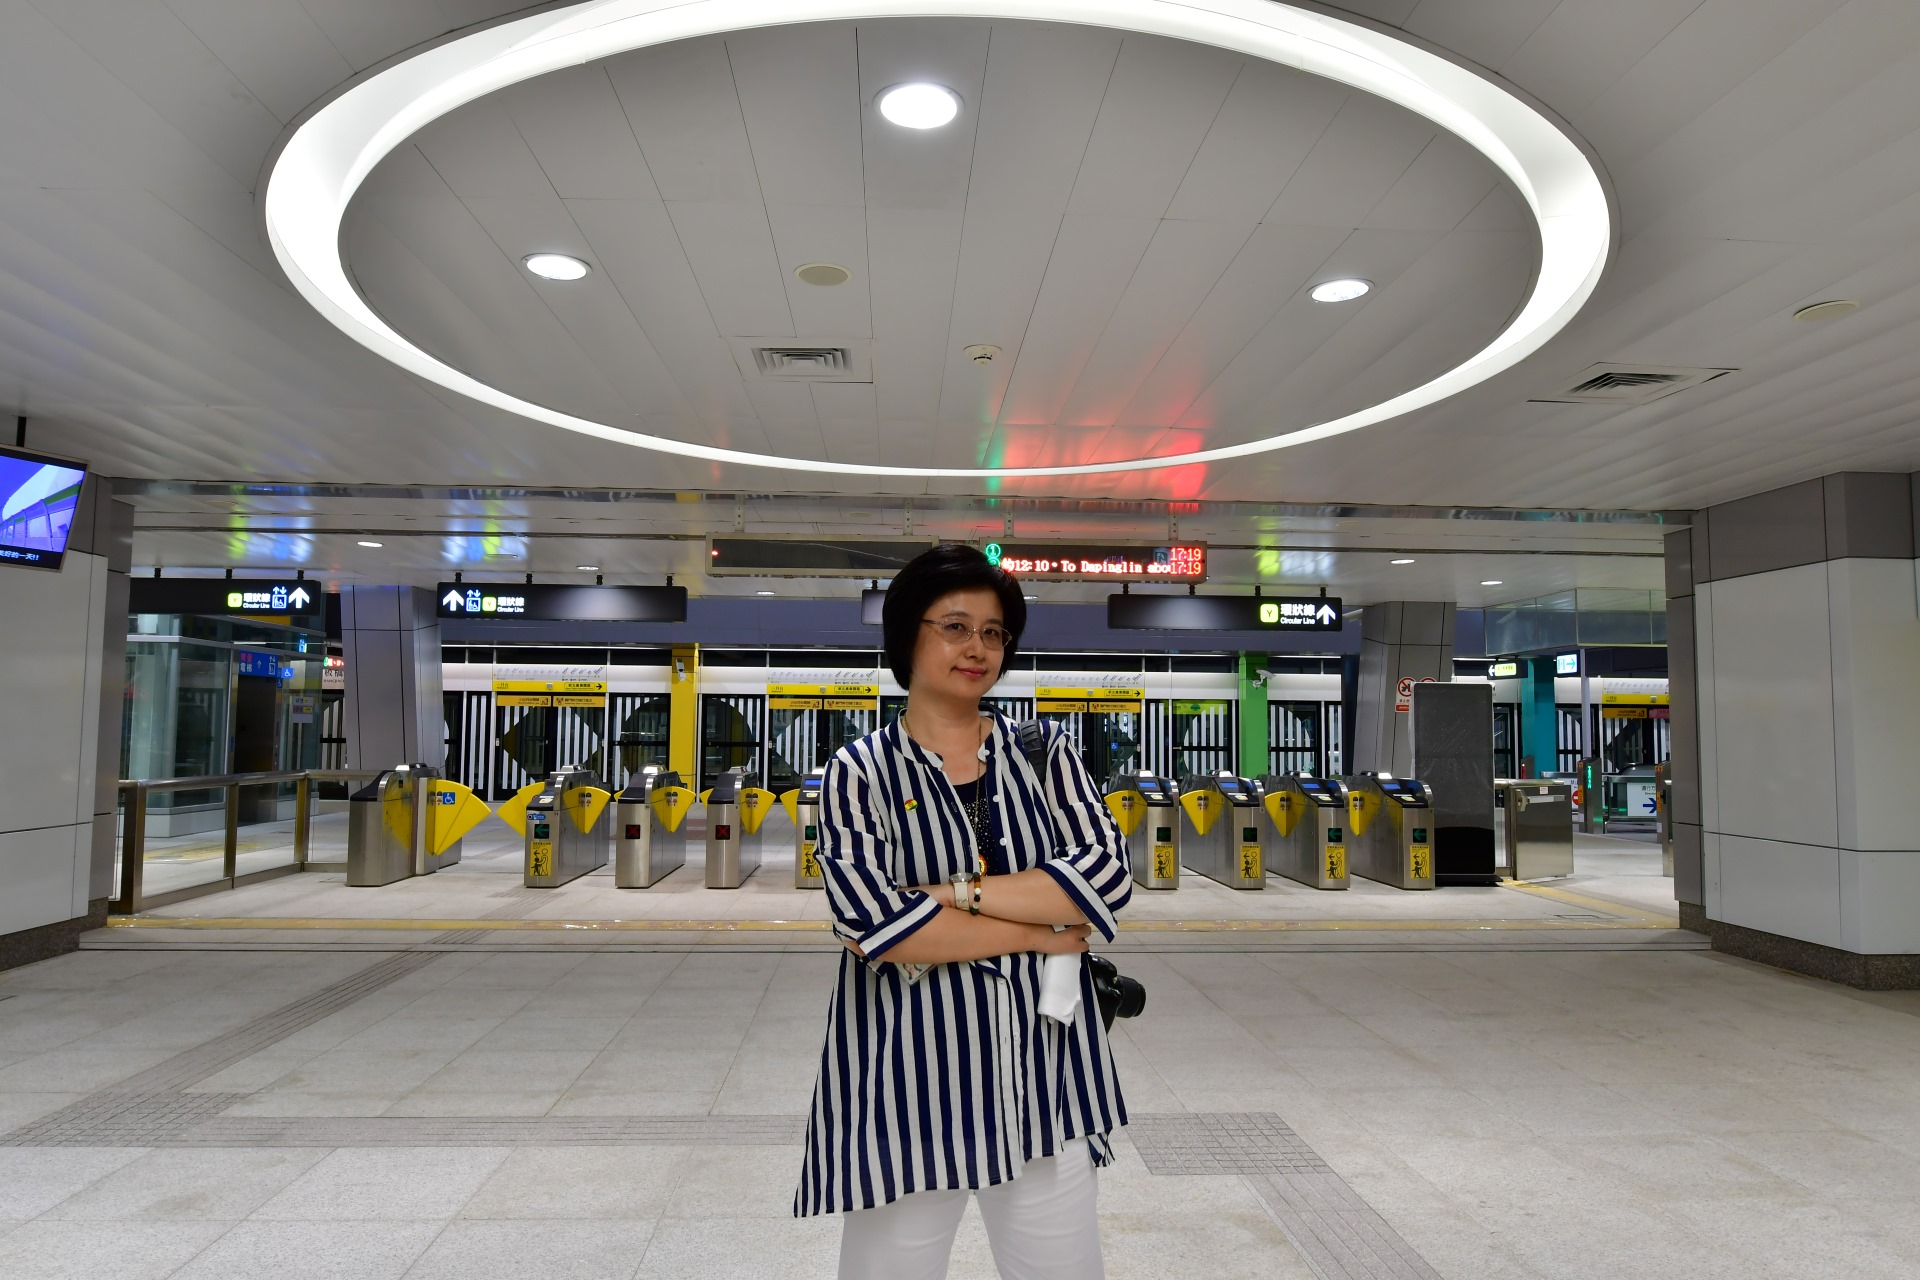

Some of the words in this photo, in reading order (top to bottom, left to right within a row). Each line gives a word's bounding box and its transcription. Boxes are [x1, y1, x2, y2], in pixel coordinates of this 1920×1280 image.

[1170, 547, 1202, 561] 17:19
[1061, 560, 1076, 573] To
[1080, 560, 1143, 574] Dapinglin
[1170, 561, 1202, 575] 17:19
[1280, 603, 1315, 616] 環狀線
